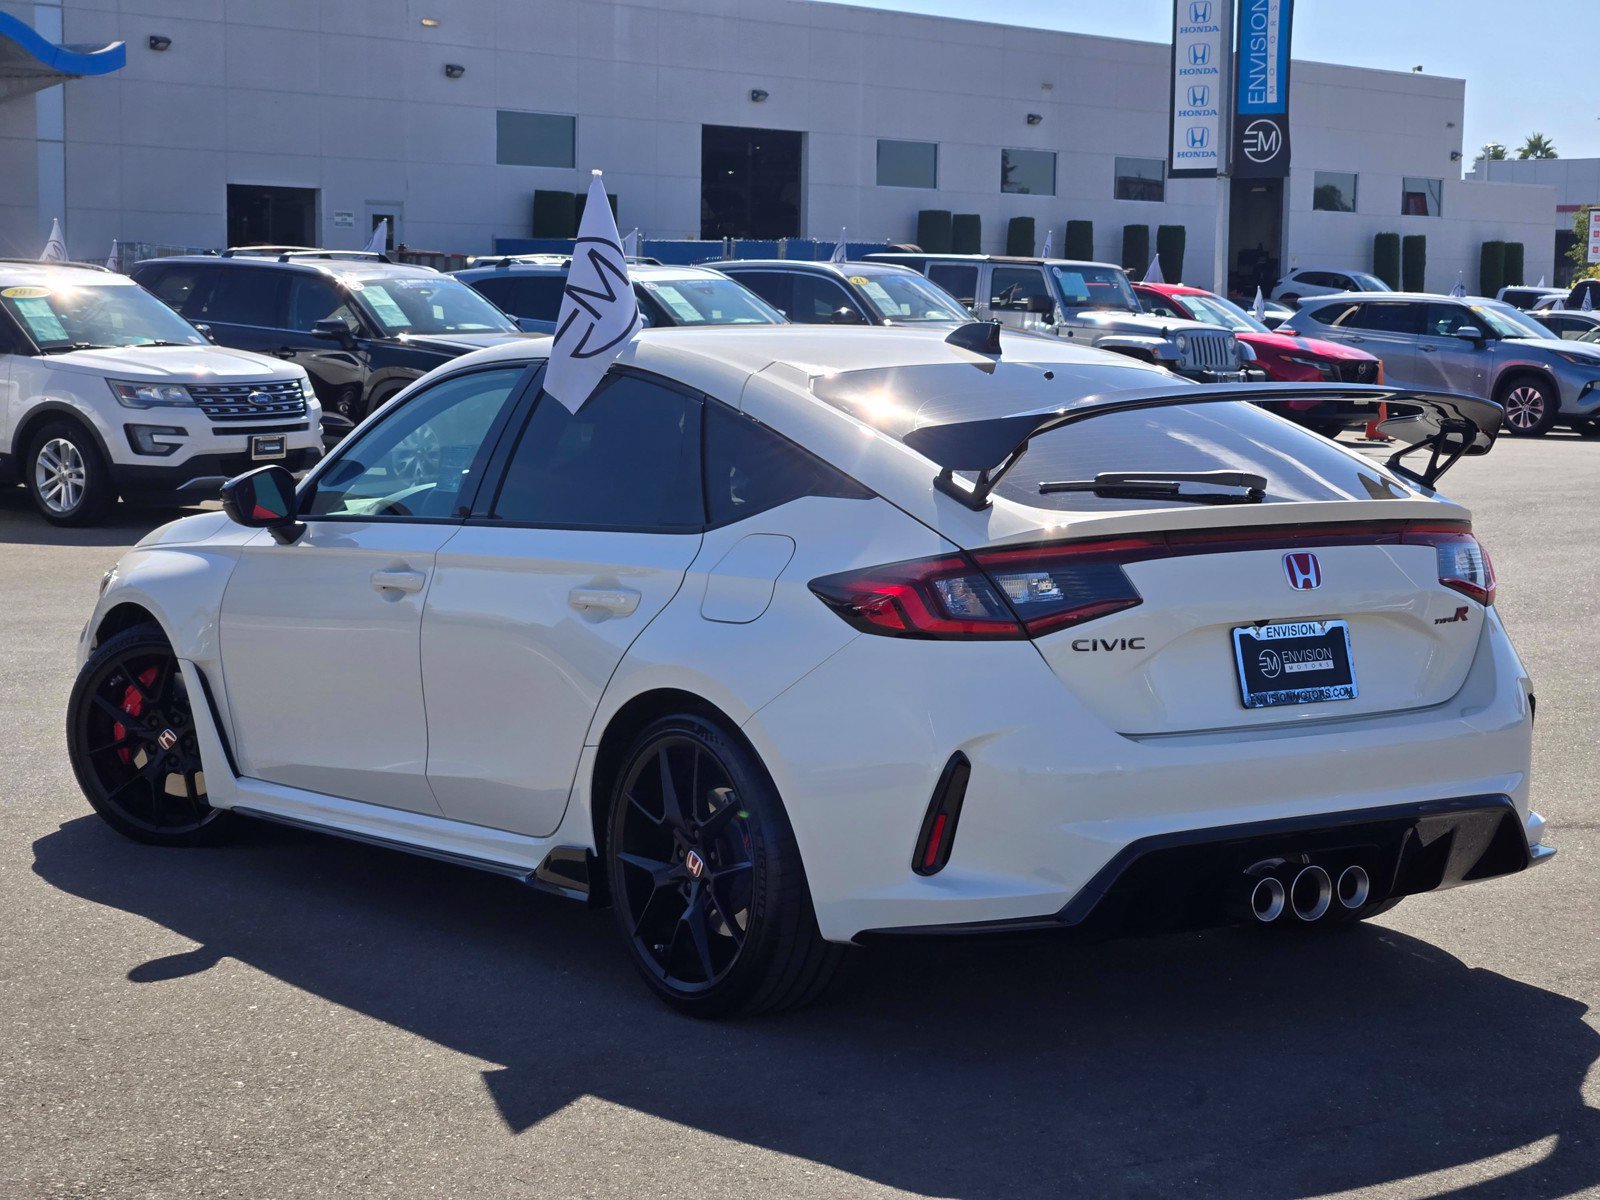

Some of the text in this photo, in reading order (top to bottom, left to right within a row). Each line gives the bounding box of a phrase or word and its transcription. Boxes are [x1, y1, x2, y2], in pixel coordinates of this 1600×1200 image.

[1180, 25, 1220, 34] HONDA
[1247, 0, 1267, 104] ENVISION
[1269, 4, 1278, 95] MOTORS
[1179, 67, 1219, 76] HONDA
[1178, 109, 1218, 117] HONDA
[1176, 151, 1217, 159] HONDA
[1266, 624, 1317, 638] ENVISION
[1071, 637, 1146, 652] CIVIC
[1281, 647, 1333, 663] ENVISION
[1288, 662, 1330, 671] MOTORS
[1250, 686, 1355, 705] ENVISIONMOTORS.COM
